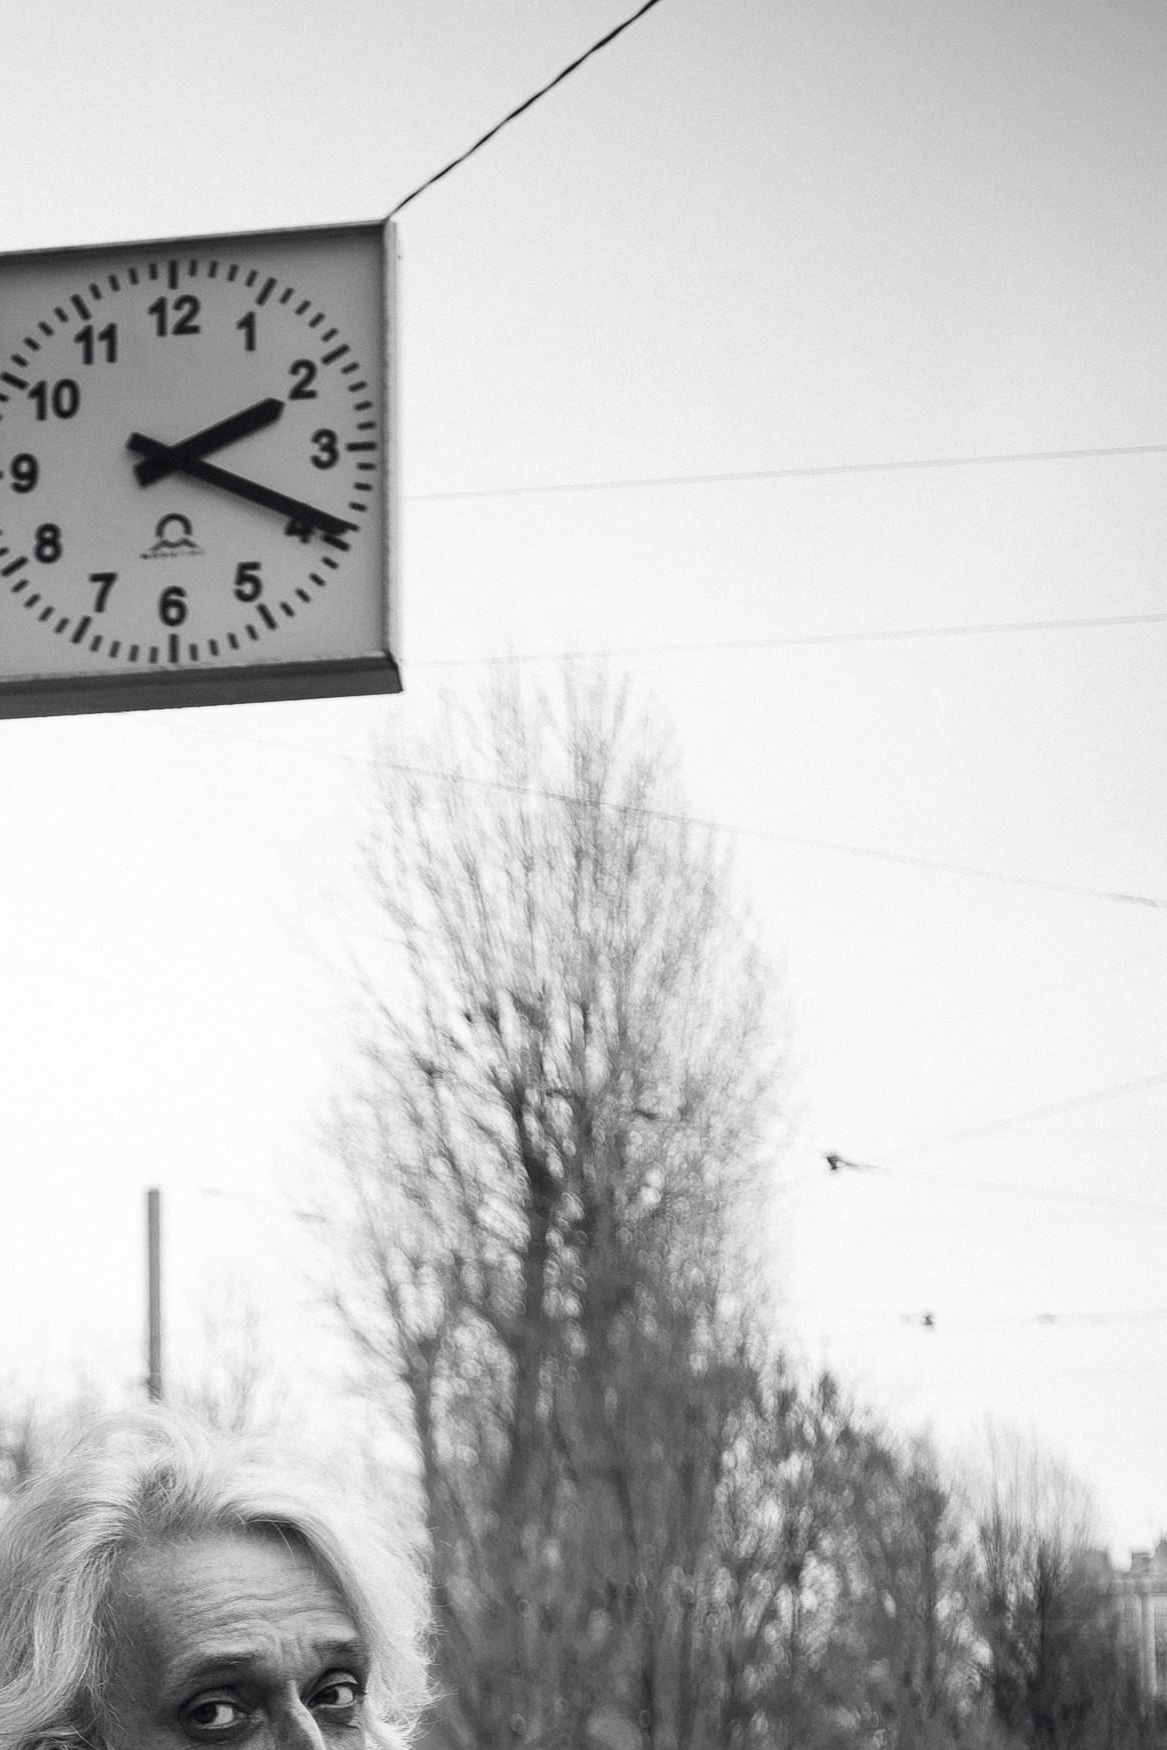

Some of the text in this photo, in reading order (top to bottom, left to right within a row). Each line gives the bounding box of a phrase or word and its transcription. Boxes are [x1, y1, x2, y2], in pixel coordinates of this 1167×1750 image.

[147, 294, 201, 338] 12
[236, 311, 256, 352] 1
[73, 322, 118, 366] 11
[27, 378, 81, 422] 10
[288, 358, 318, 401] 2
[311, 428, 340, 470] 3
[10, 452, 40, 494] 9
[34, 523, 63, 564] 8
[89, 572, 118, 613] 7
[234, 561, 263, 603] 5
[159, 585, 188, 627] 6
